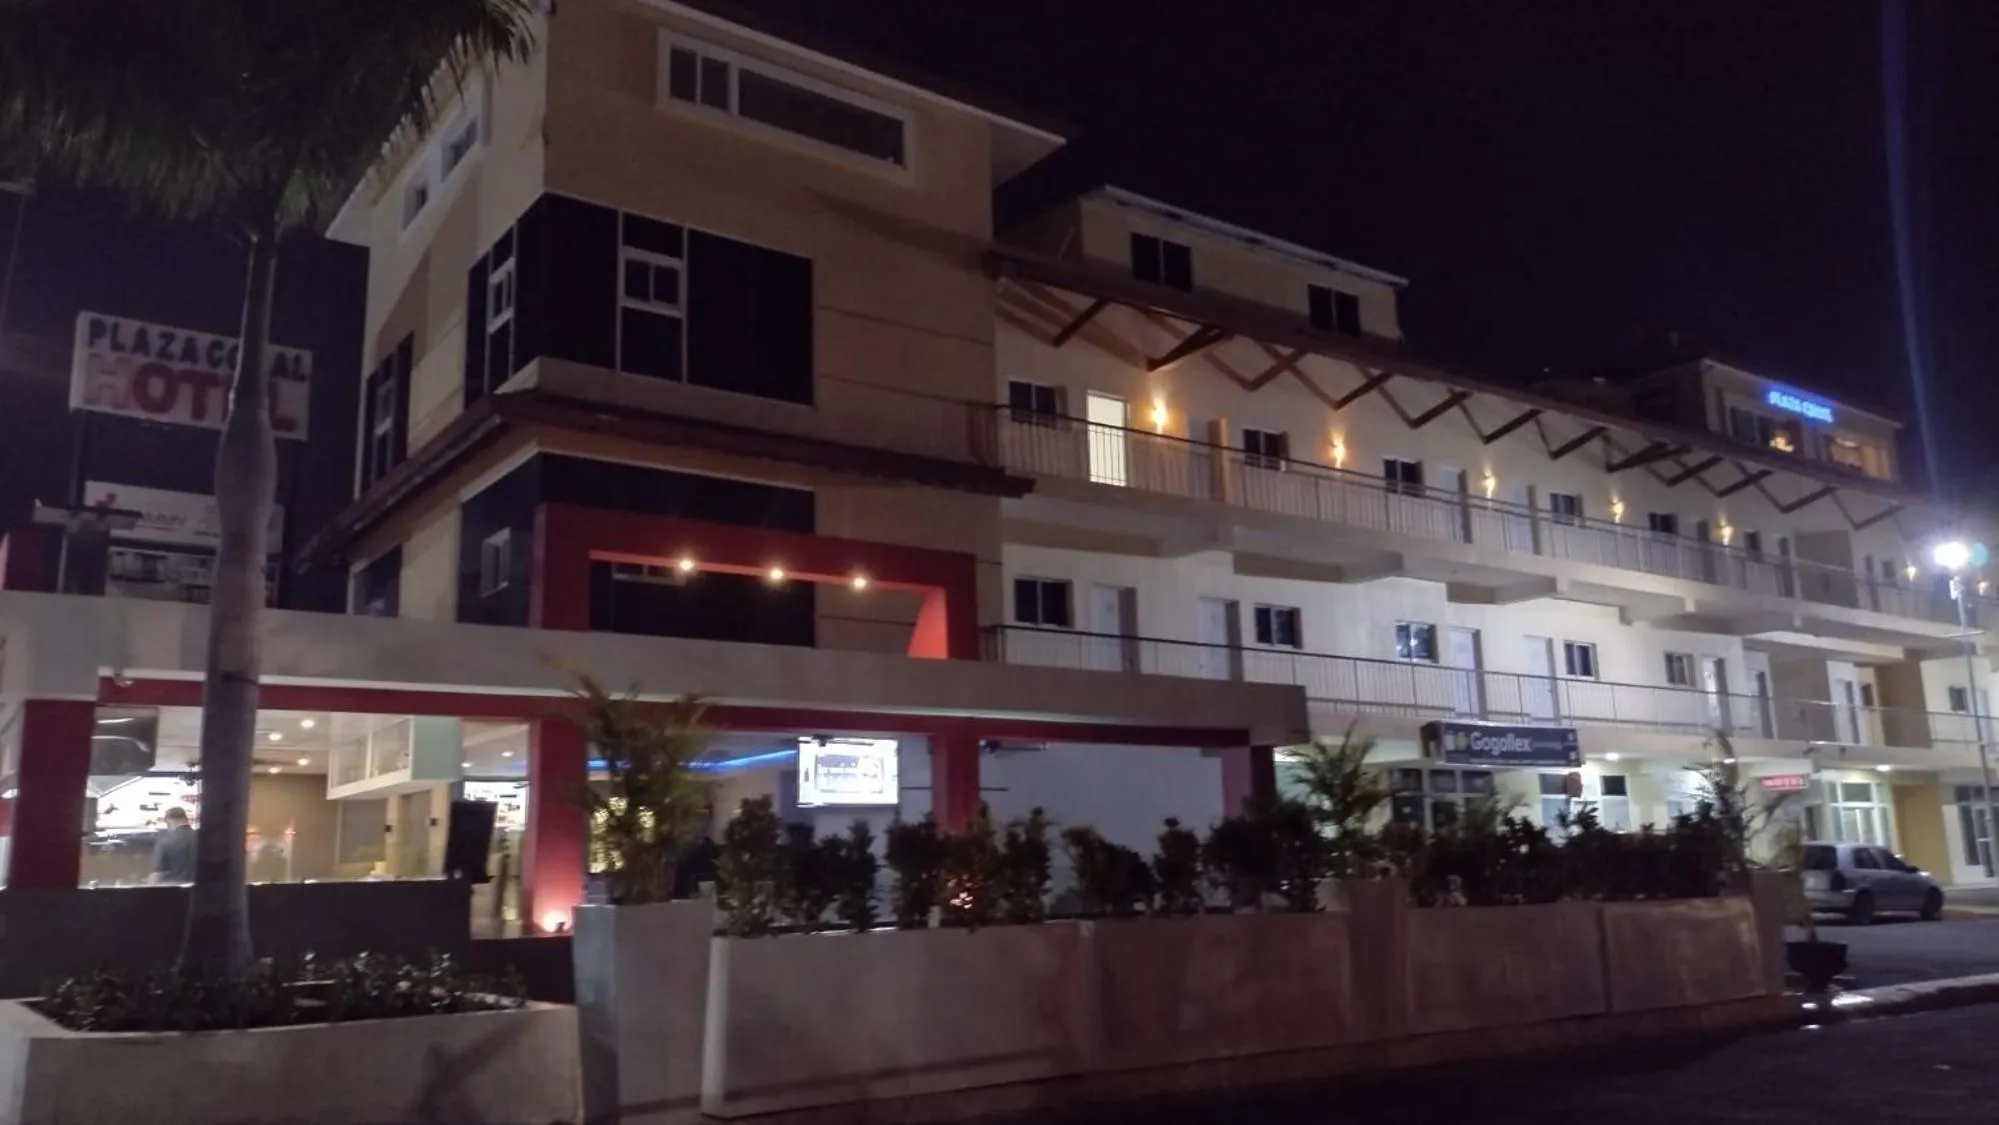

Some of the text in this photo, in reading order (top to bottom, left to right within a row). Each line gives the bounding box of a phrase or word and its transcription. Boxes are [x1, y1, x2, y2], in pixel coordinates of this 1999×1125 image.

[88, 317, 200, 364] PLAZA
[83, 352, 297, 433] HOTL
[1470, 730, 1532, 755] Gogoflex
